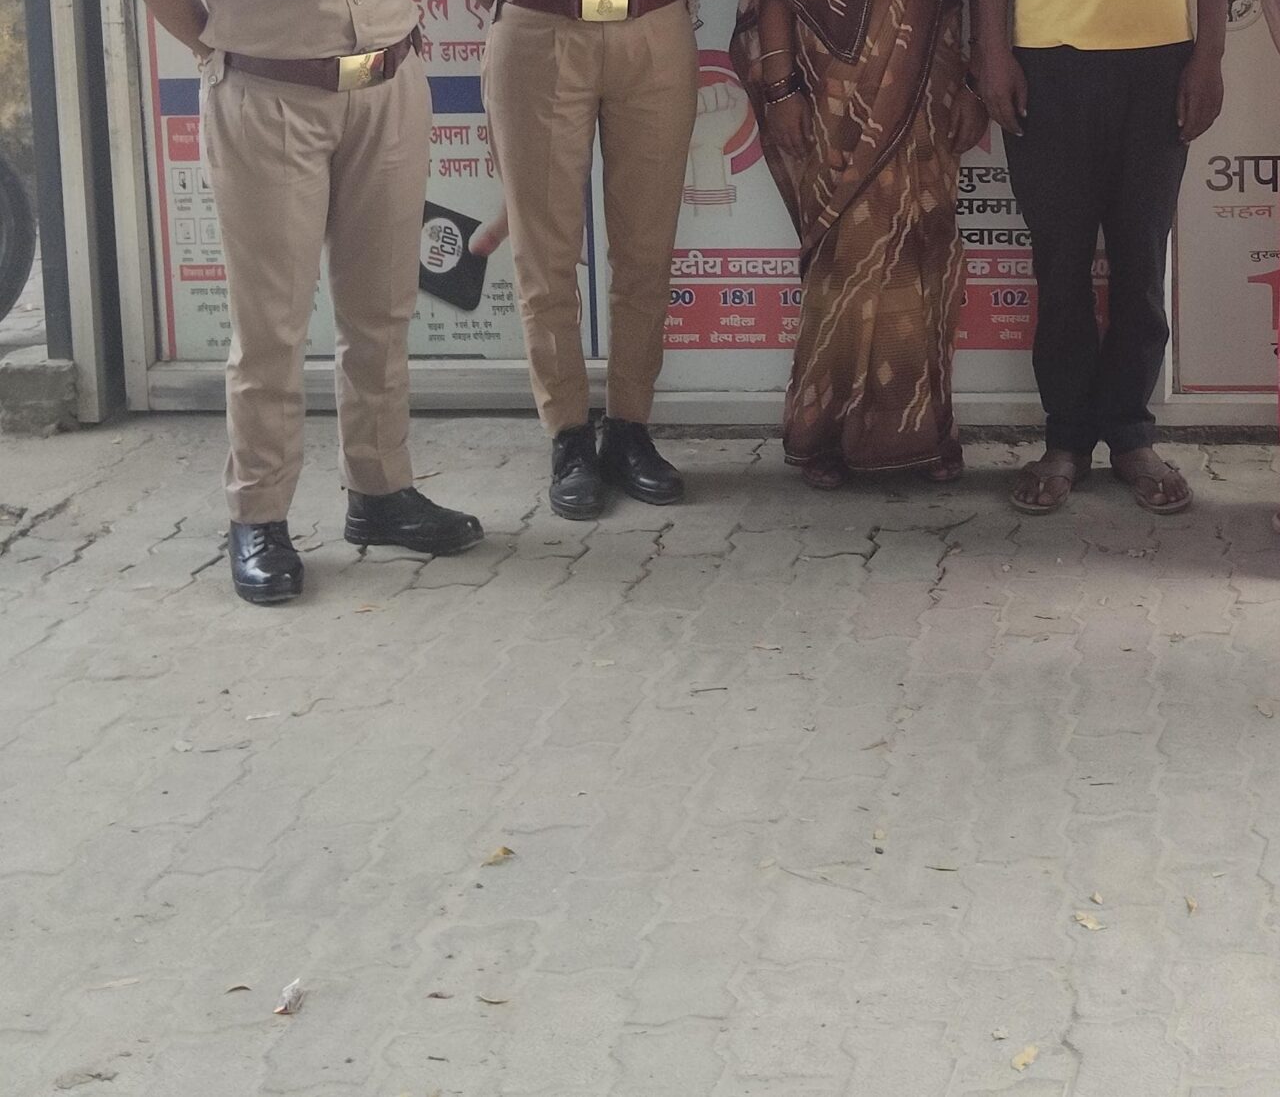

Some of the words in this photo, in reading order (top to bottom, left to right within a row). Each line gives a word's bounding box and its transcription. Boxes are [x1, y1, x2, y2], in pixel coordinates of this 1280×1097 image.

[439, 42, 486, 62] डाउन
[429, 125, 470, 145] अपना
[438, 157, 480, 178] अपना
[1212, 204, 1276, 219] सहन
[440, 225, 459, 256] COP
[427, 246, 446, 267] UP
[671, 250, 723, 275] रदीय
[668, 288, 695, 307] 90
[719, 288, 755, 307] 181
[990, 289, 1029, 306] 102
[720, 314, 756, 326] महिला
